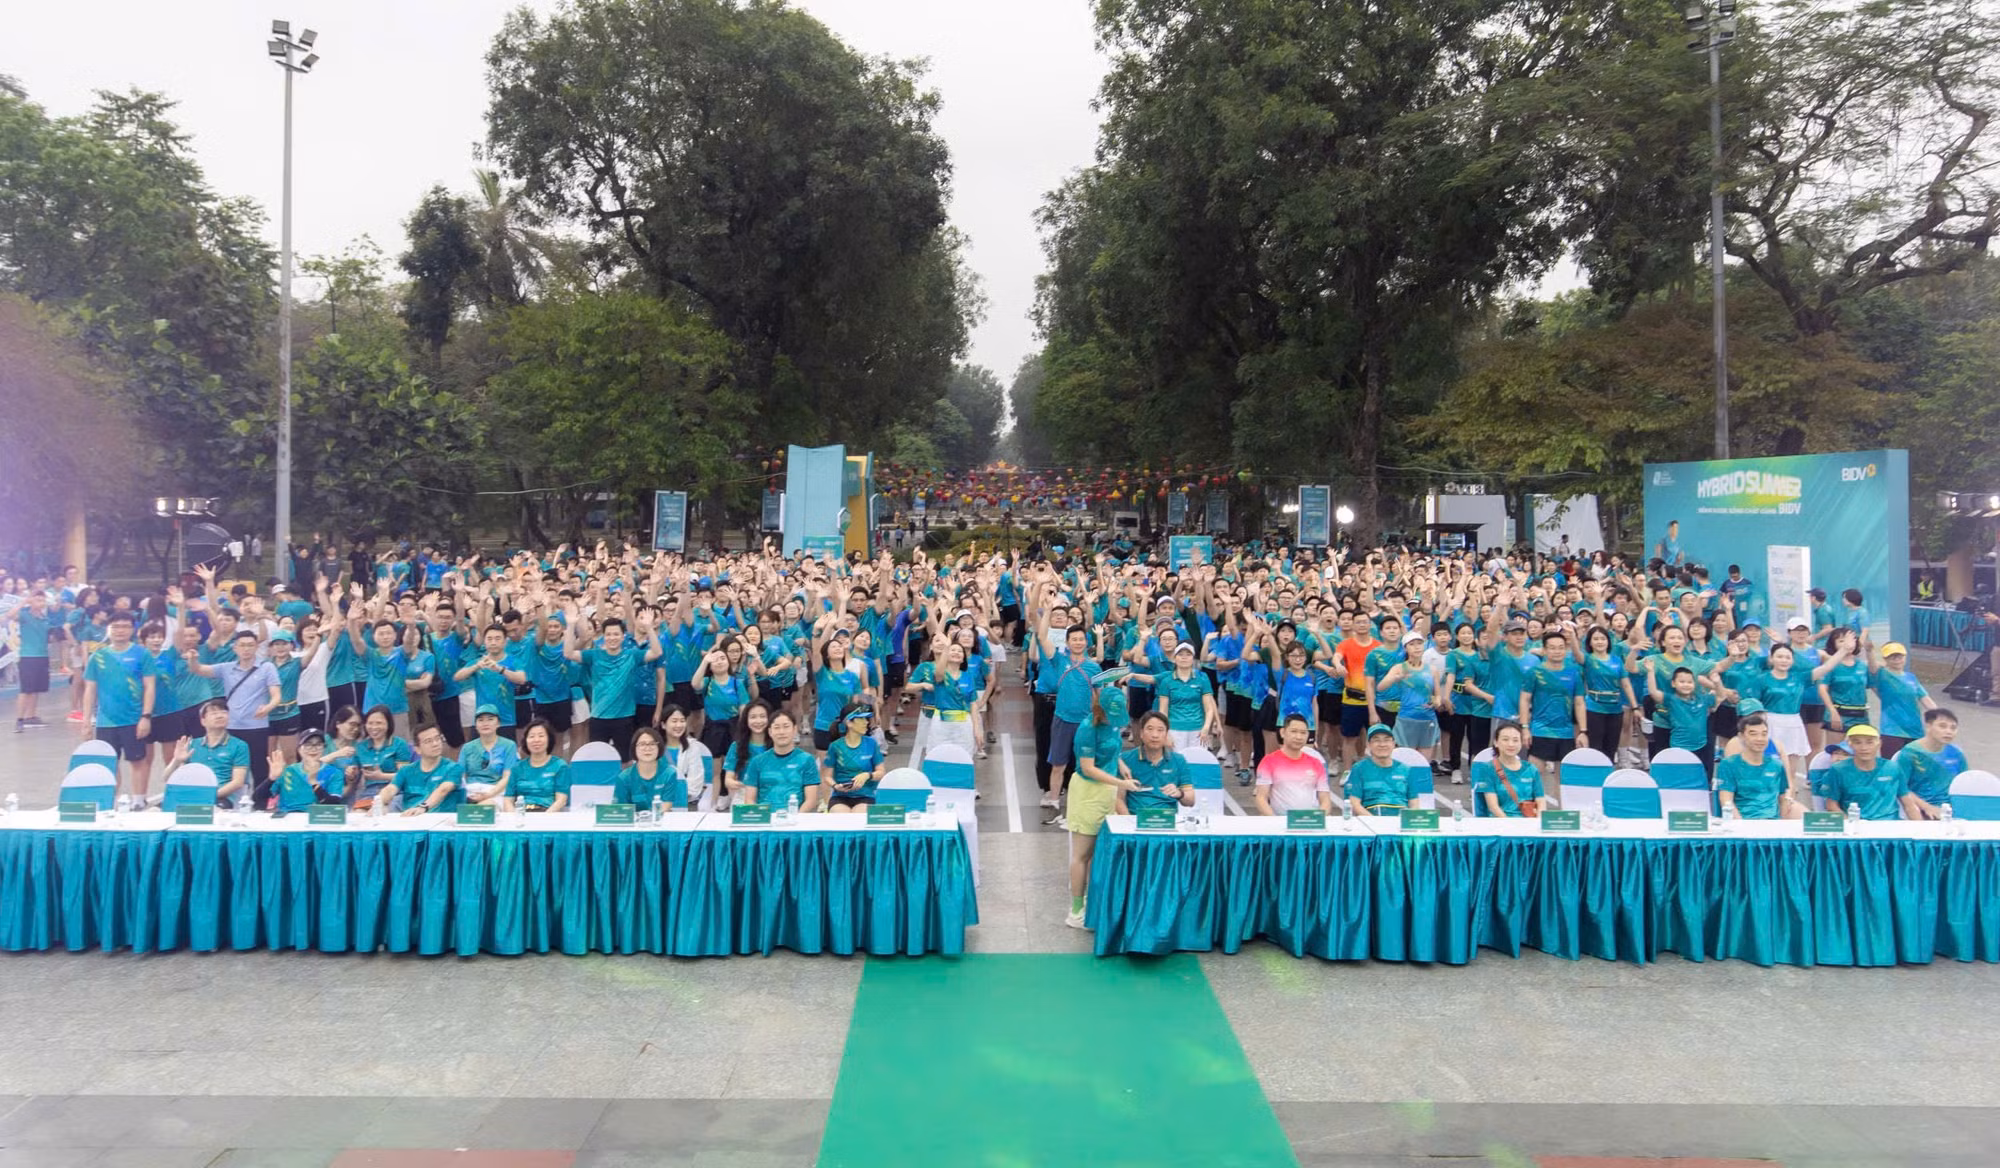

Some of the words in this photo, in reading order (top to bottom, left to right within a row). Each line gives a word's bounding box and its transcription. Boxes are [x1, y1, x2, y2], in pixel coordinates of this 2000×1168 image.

[1841, 466, 1867, 481] BIDV
[1697, 470, 1745, 498] HYBRID
[1778, 502, 1802, 515] BIDV
